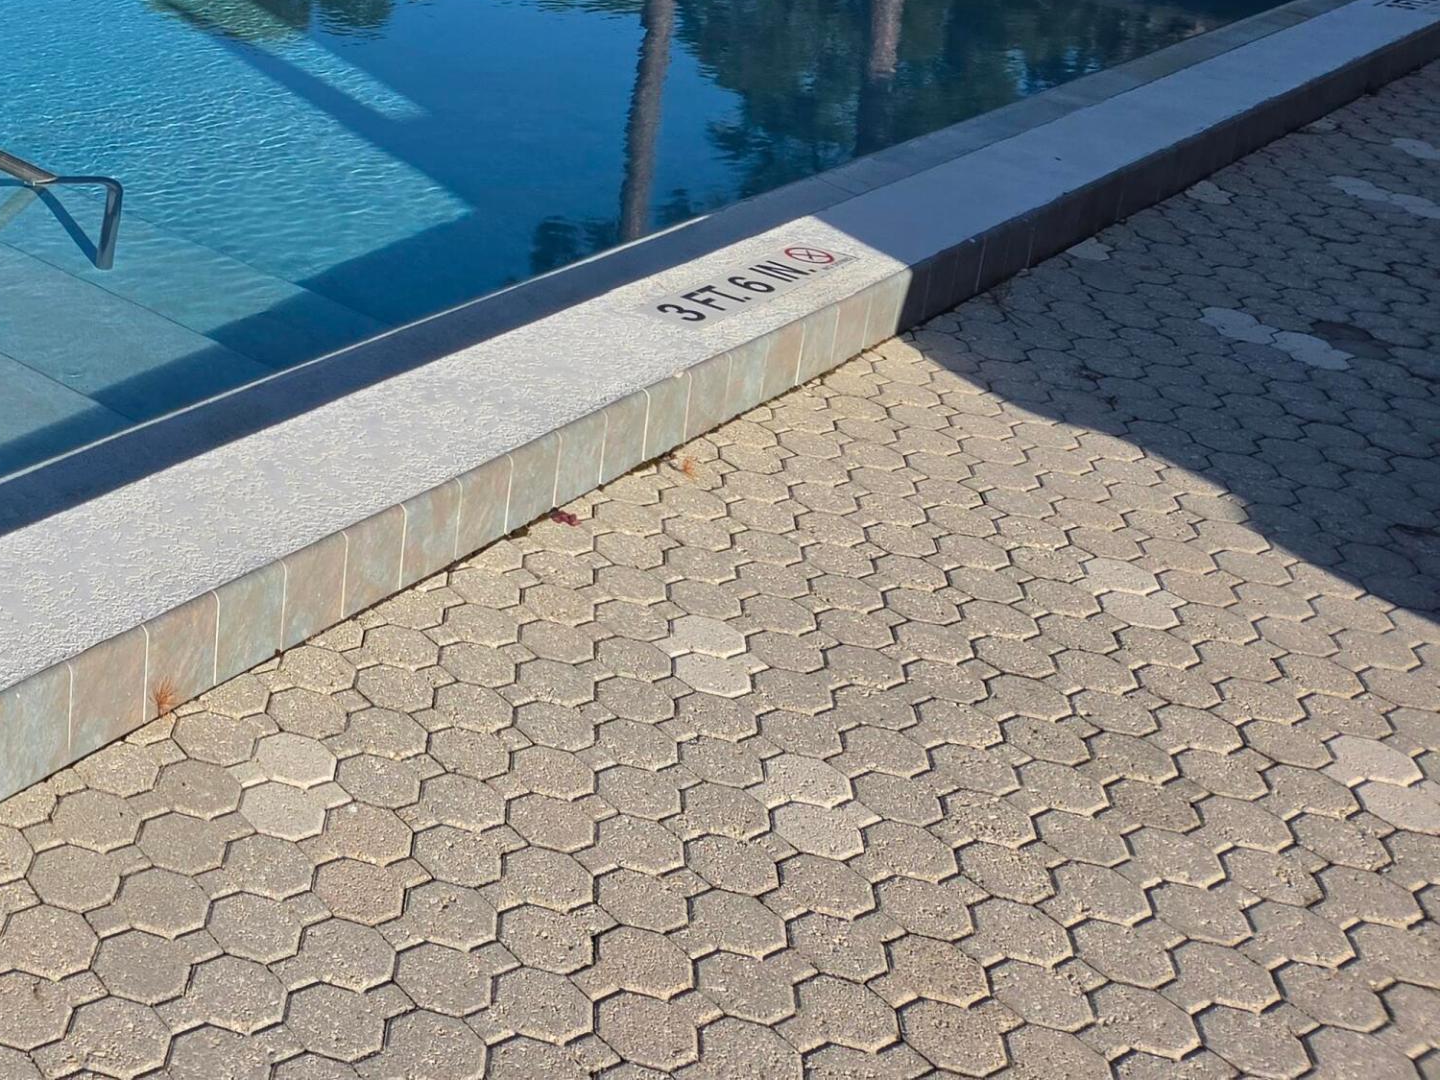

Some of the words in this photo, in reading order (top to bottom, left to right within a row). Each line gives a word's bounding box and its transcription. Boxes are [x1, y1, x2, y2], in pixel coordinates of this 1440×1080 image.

[748, 260, 817, 283] IN.
[727, 276, 776, 293] 6
[681, 284, 752, 311] FT.
[657, 303, 706, 322] 3
